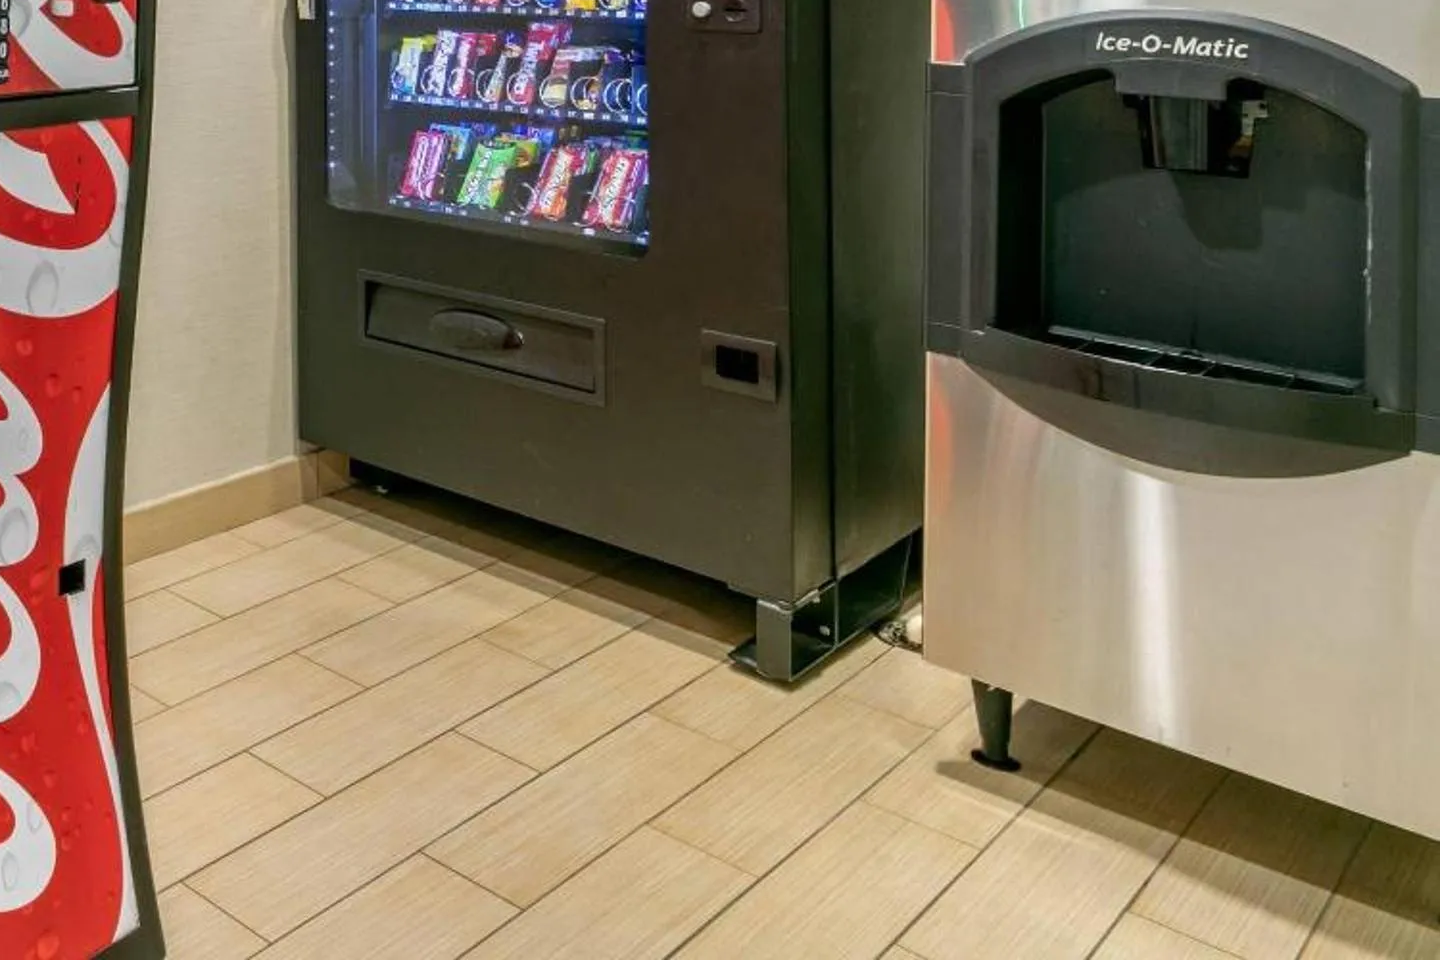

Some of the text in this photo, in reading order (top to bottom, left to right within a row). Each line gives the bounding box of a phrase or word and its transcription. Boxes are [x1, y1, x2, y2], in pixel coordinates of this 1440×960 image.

[0, 17, 8, 35] 8
[0, 42, 8, 58] 0
[1095, 31, 1250, 60] Ice-O-Matic
